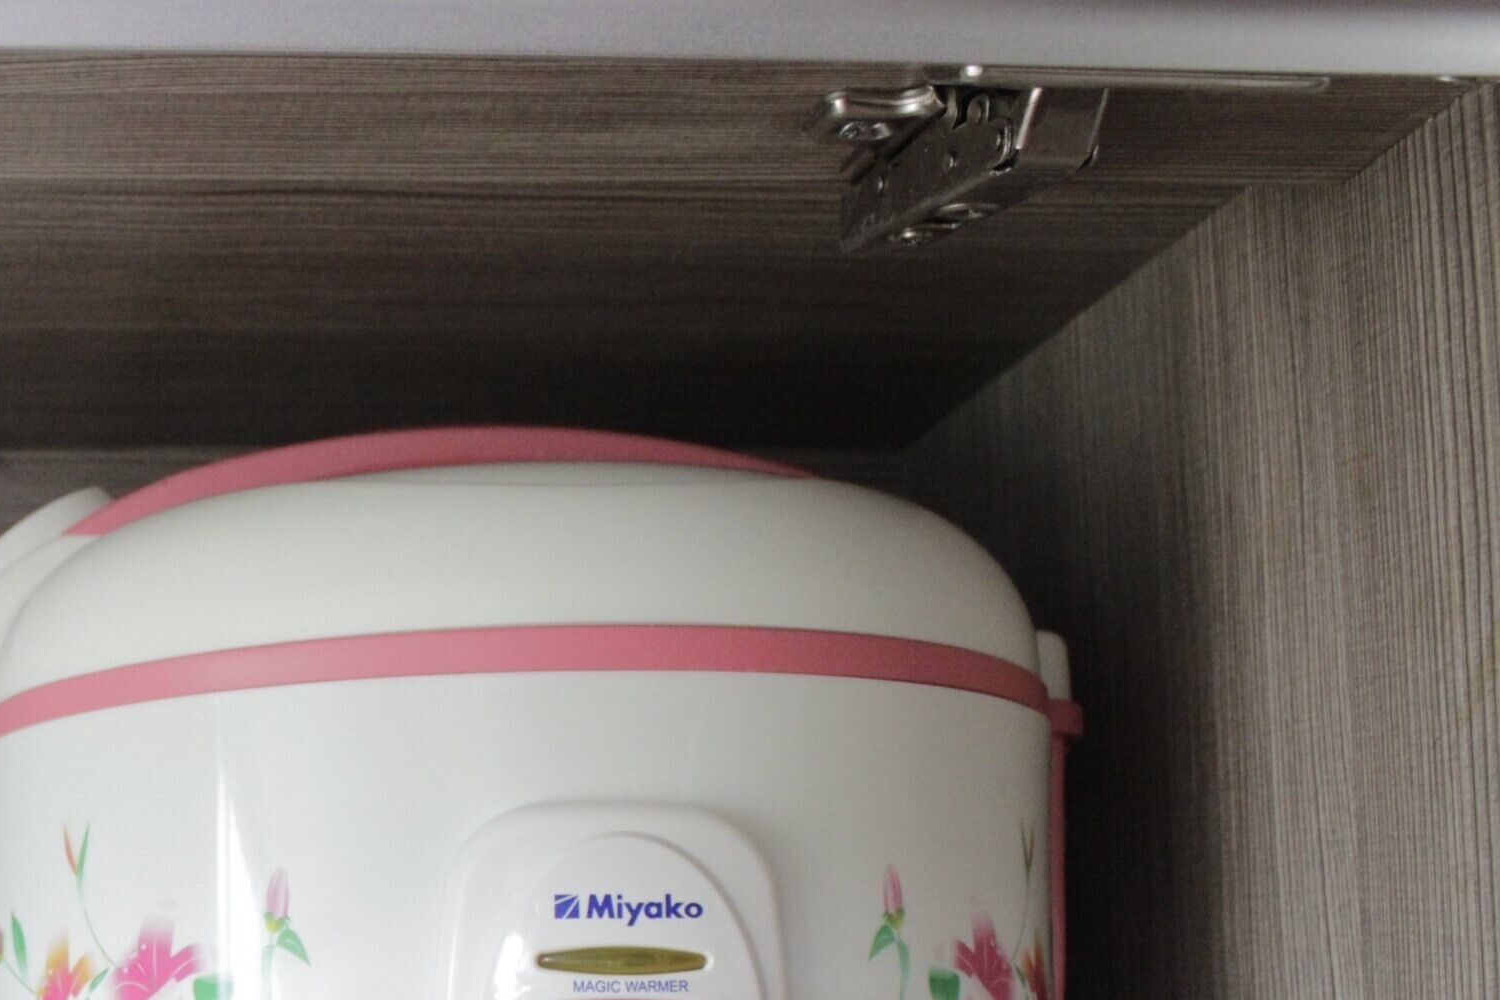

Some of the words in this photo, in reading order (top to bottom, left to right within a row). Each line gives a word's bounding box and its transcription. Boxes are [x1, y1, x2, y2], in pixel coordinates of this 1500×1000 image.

[586, 893, 704, 927] Miyako
[572, 980, 621, 993] MAGIC
[625, 980, 689, 993] WARMER
